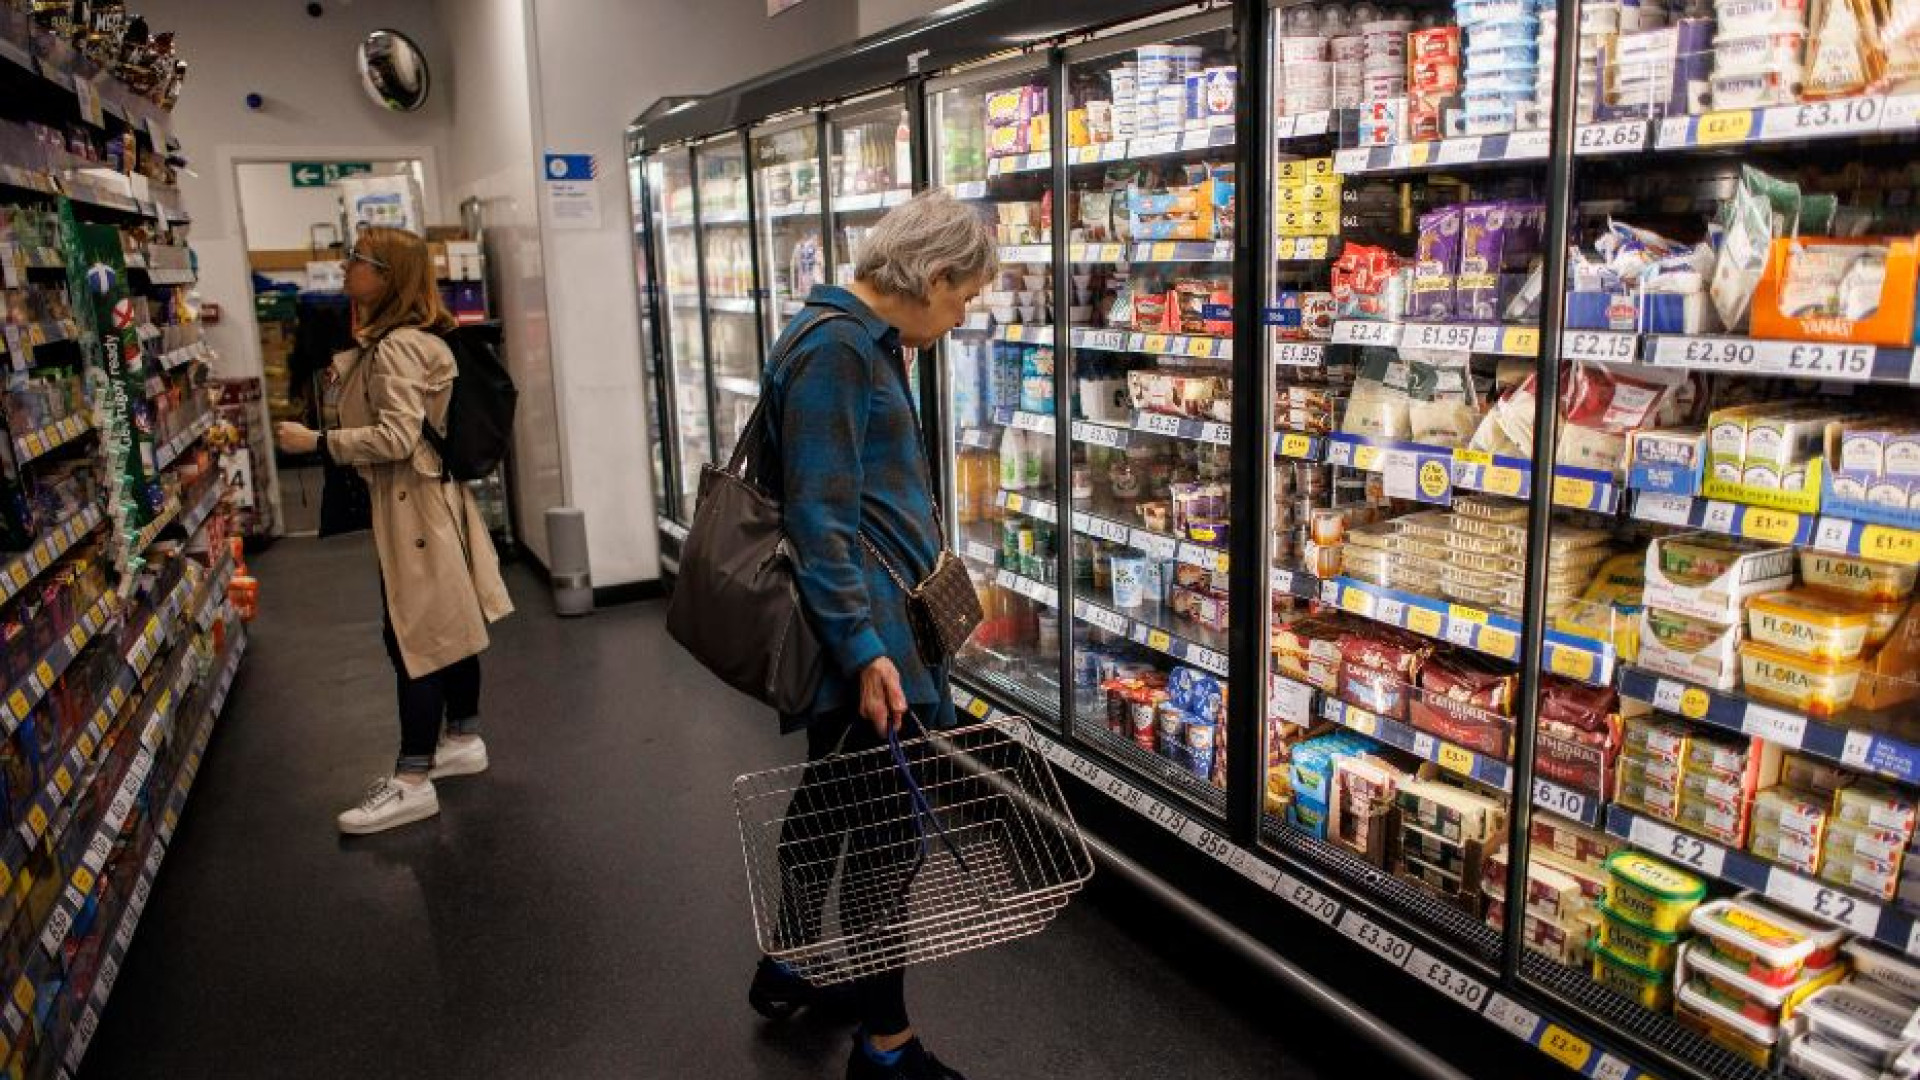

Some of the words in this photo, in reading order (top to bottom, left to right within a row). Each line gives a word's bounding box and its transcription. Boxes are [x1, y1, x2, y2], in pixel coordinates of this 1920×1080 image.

[1796, 98, 1876, 127] £3.10
[1579, 124, 1642, 147] £2.65
[1350, 324, 1393, 341] £2.4
[1421, 326, 1470, 346] £1.95
[1572, 334, 1633, 357] £2.15
[102, 334, 120, 375] ready
[1685, 341, 1754, 364] £2.90
[1788, 345, 1866, 373] £2.15
[231, 470, 244, 488] 4
[1816, 558, 1872, 581] FLORA
[1763, 615, 1814, 641] FLORA
[1756, 660, 1809, 688] FLORA
[1537, 733, 1599, 764] ATHEDRAL
[1197, 830, 1230, 857] 95p
[1672, 834, 1705, 866] £2
[1292, 886, 1336, 919] £2.70
[1813, 889, 1855, 920] £2
[1358, 923, 1406, 960] £3.30
[1427, 963, 1481, 1003] £3.30
